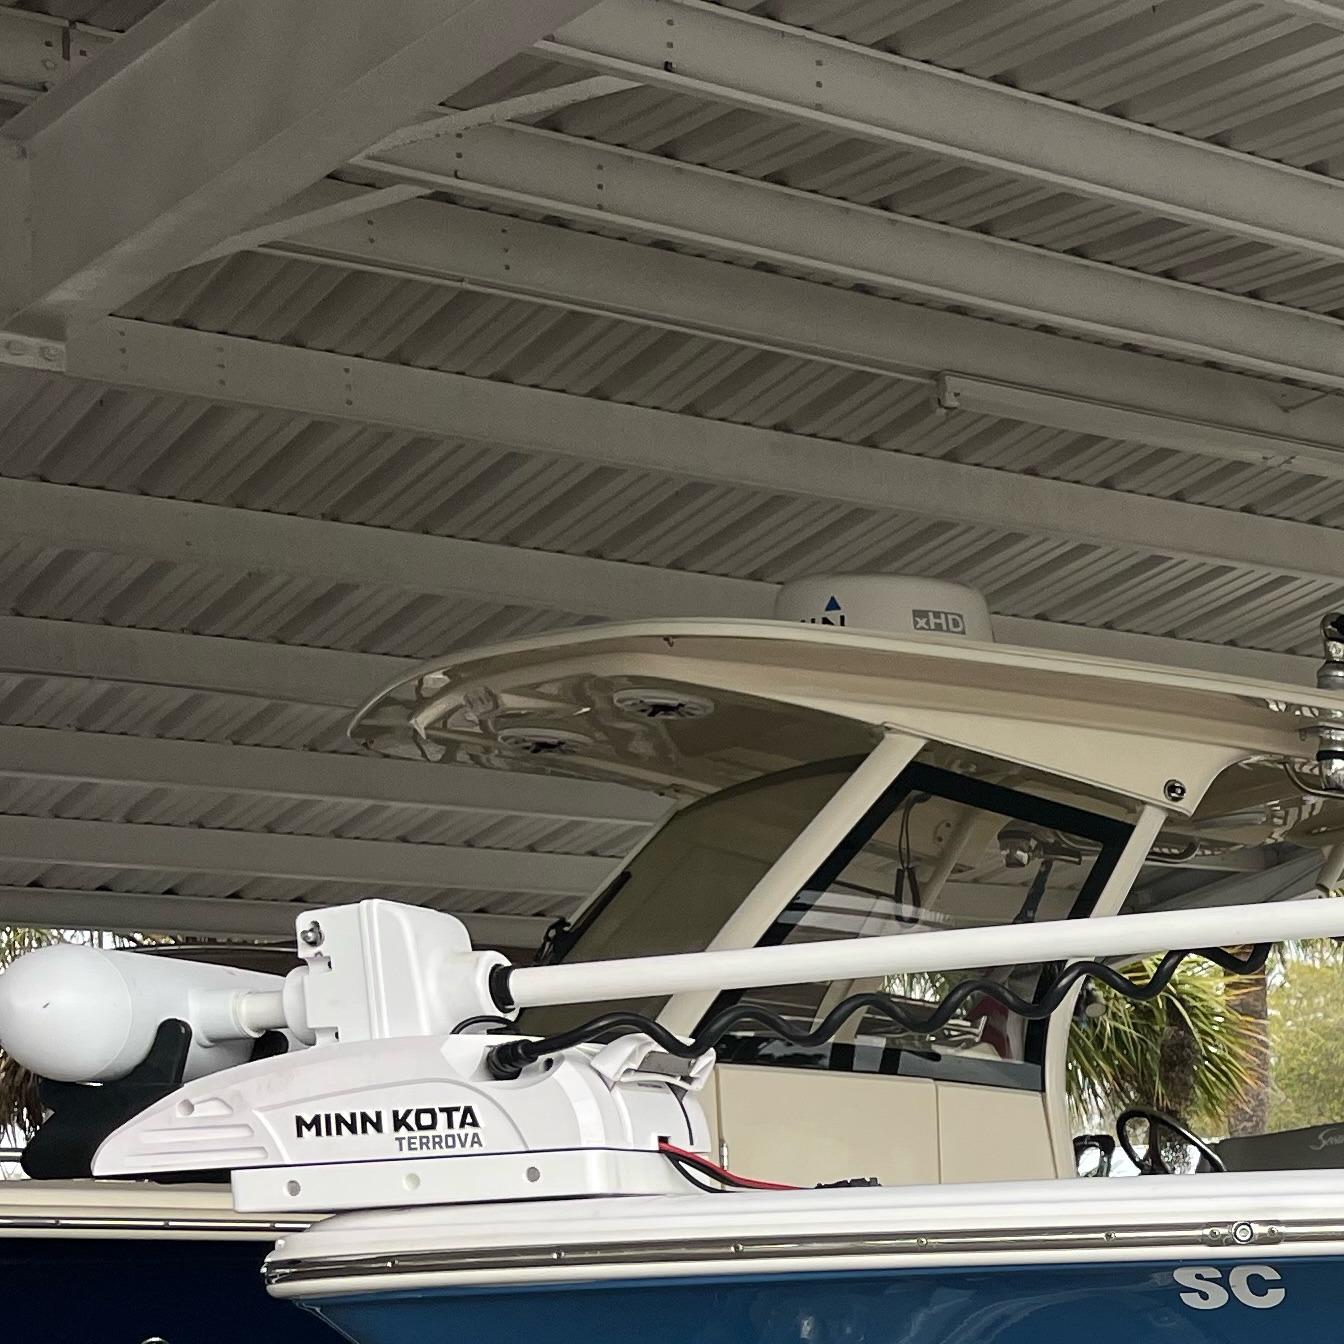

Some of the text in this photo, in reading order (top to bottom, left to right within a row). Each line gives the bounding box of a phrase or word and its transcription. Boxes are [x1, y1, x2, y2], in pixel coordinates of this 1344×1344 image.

[914, 611, 965, 633] xHD
[295, 1105, 481, 1138] MINN KOTA
[394, 1132, 483, 1152] TERROVA
[1173, 1264, 1285, 1310] SC
